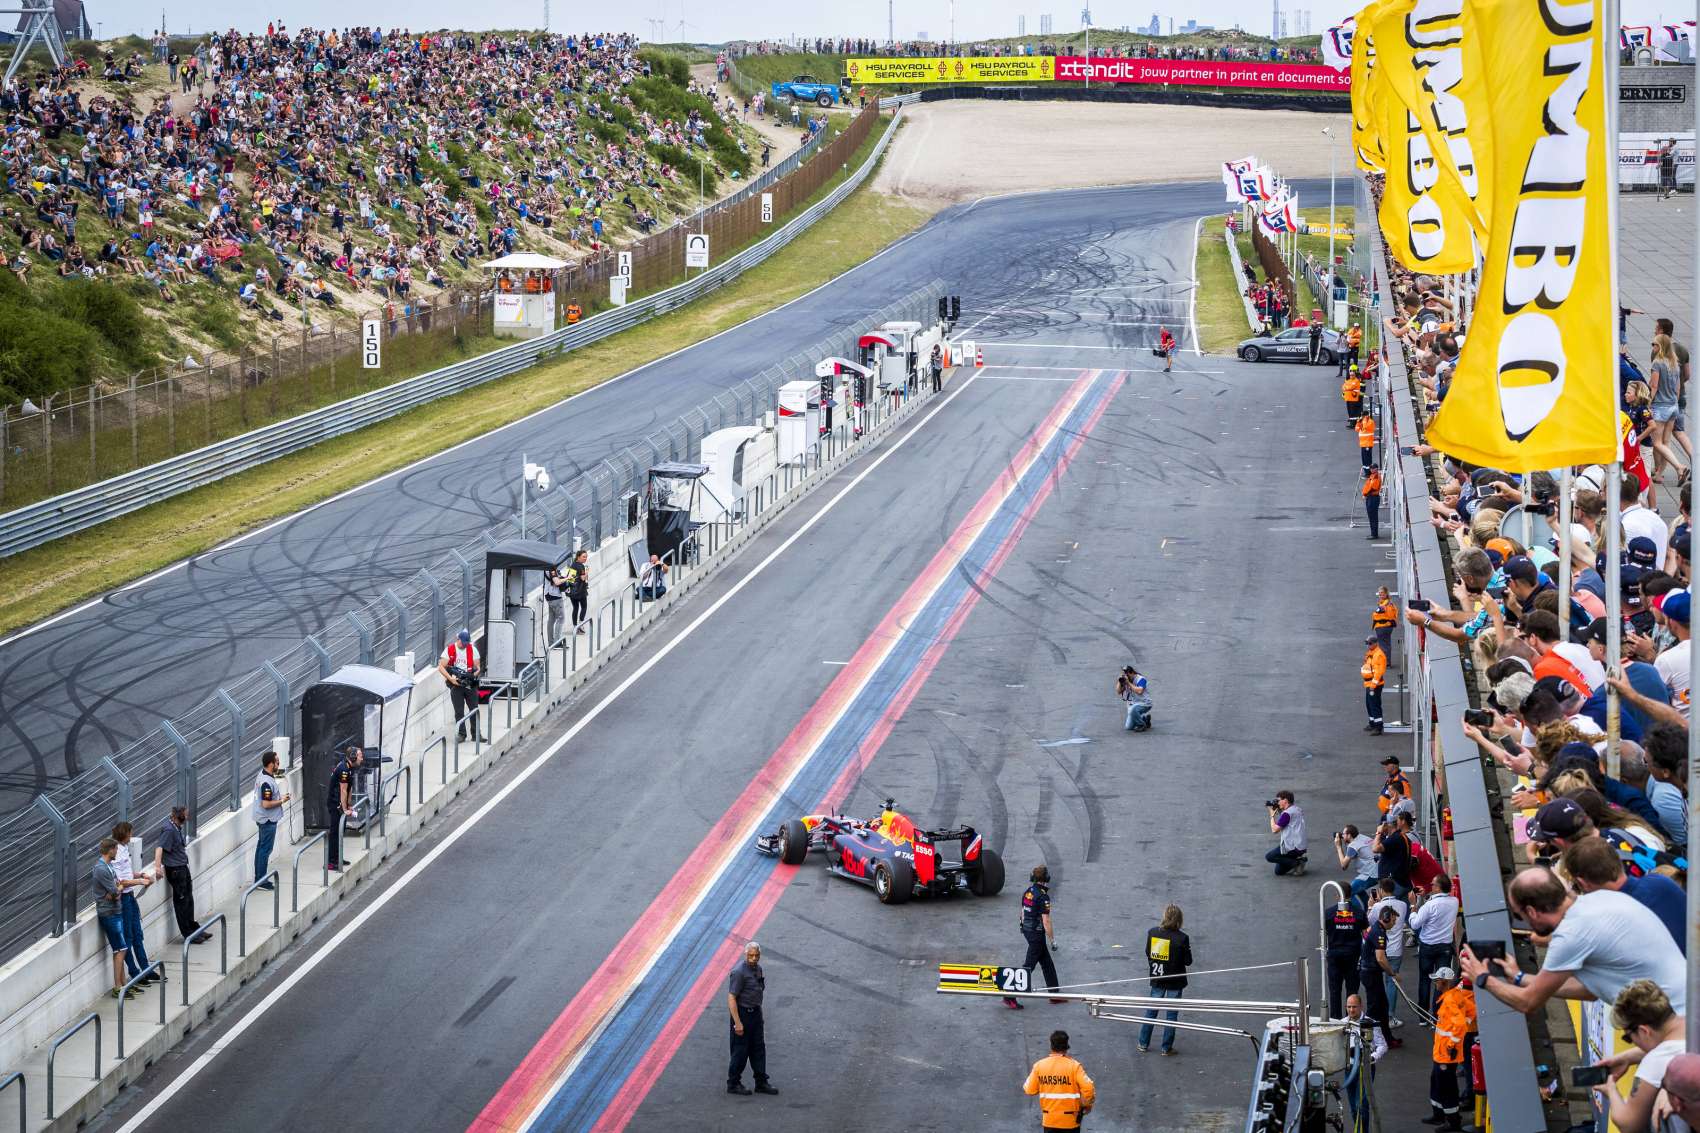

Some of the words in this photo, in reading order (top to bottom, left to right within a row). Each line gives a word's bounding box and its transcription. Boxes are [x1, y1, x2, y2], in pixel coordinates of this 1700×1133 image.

[875, 71, 924, 79] SERVICES
[1060, 61, 1134, 78] xtandit
[1140, 66, 1168, 78] jouw
[1171, 68, 1213, 80] partner
[1216, 69, 1227, 79] in
[1230, 70, 1257, 83] print
[1261, 73, 1274, 81] en
[1277, 71, 1334, 84] document
[1338, 76, 1351, 84] so
[1407, 108, 1444, 262] BO
[763, 203, 771, 221] 50
[366, 323, 378, 366] 150
[915, 844, 933, 857] ESSO
[1151, 951, 1168, 960] Nikon
[1152, 962, 1164, 977] 24
[1002, 968, 1028, 991] 29
[1038, 1075, 1072, 1086] MARSHAL
